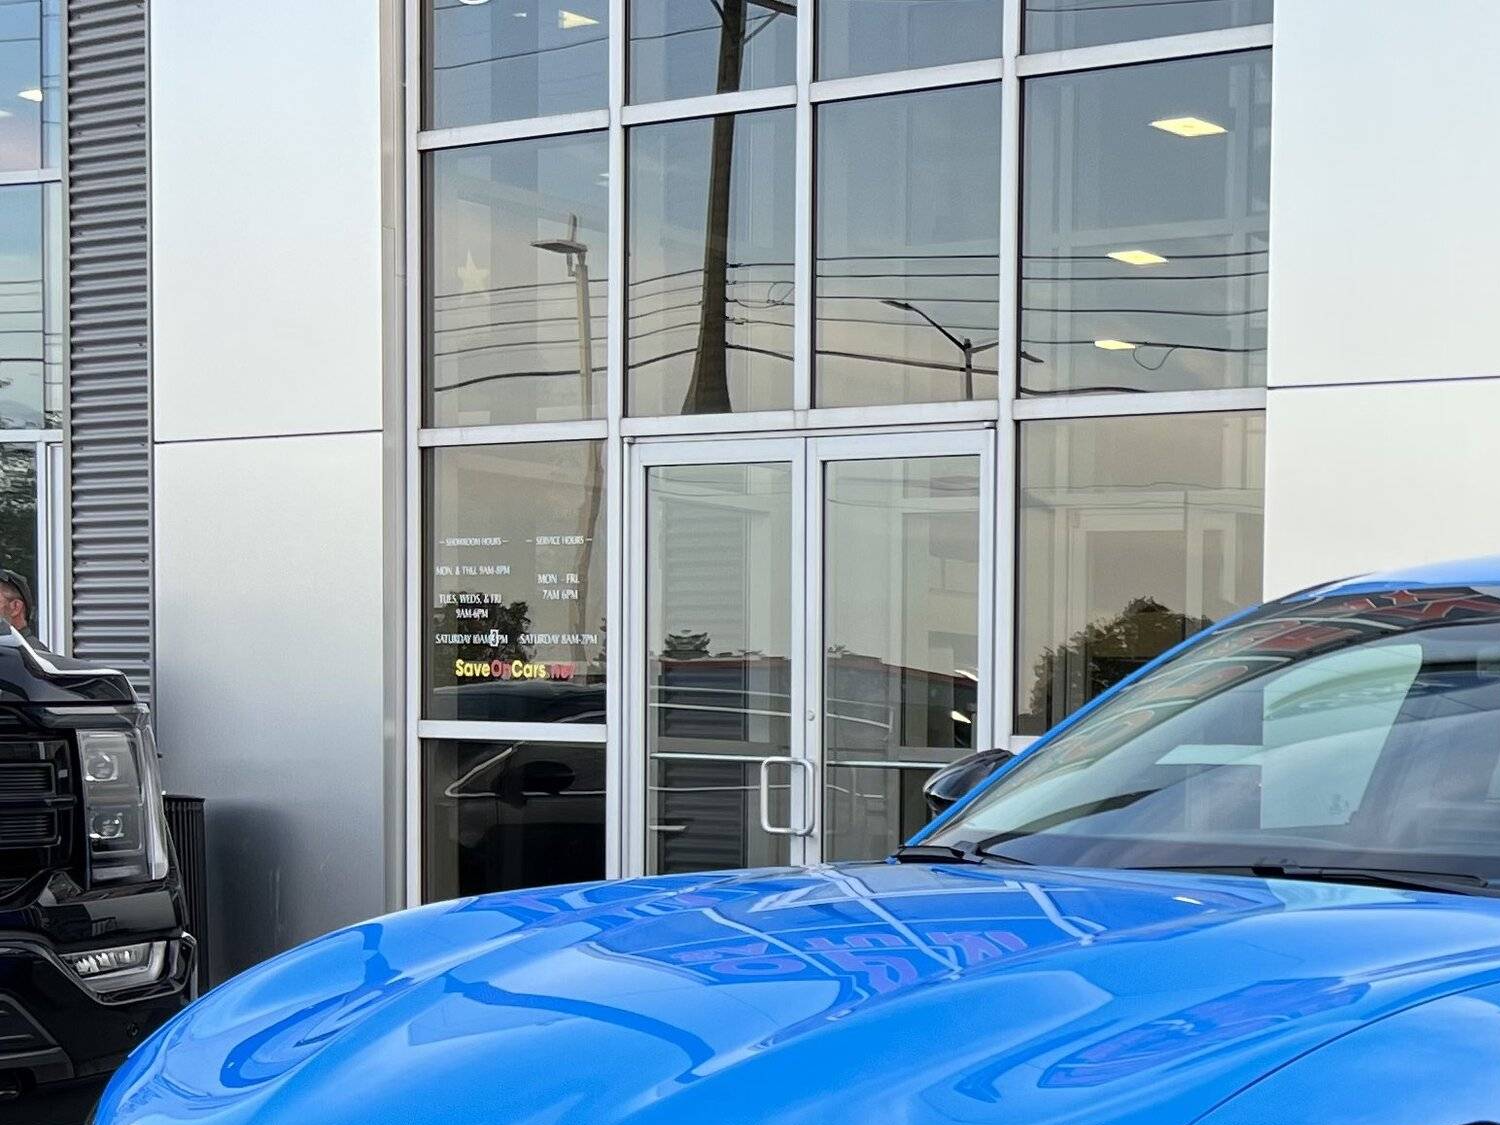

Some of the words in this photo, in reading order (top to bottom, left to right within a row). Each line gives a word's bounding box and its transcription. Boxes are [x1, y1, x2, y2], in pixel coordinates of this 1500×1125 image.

[480, 537, 502, 546] HOURS
[536, 536, 560, 545] SERVICE
[561, 536, 584, 545] HOURS
[435, 633, 472, 644] SATURDAY
[519, 633, 560, 644] SATURDAY
